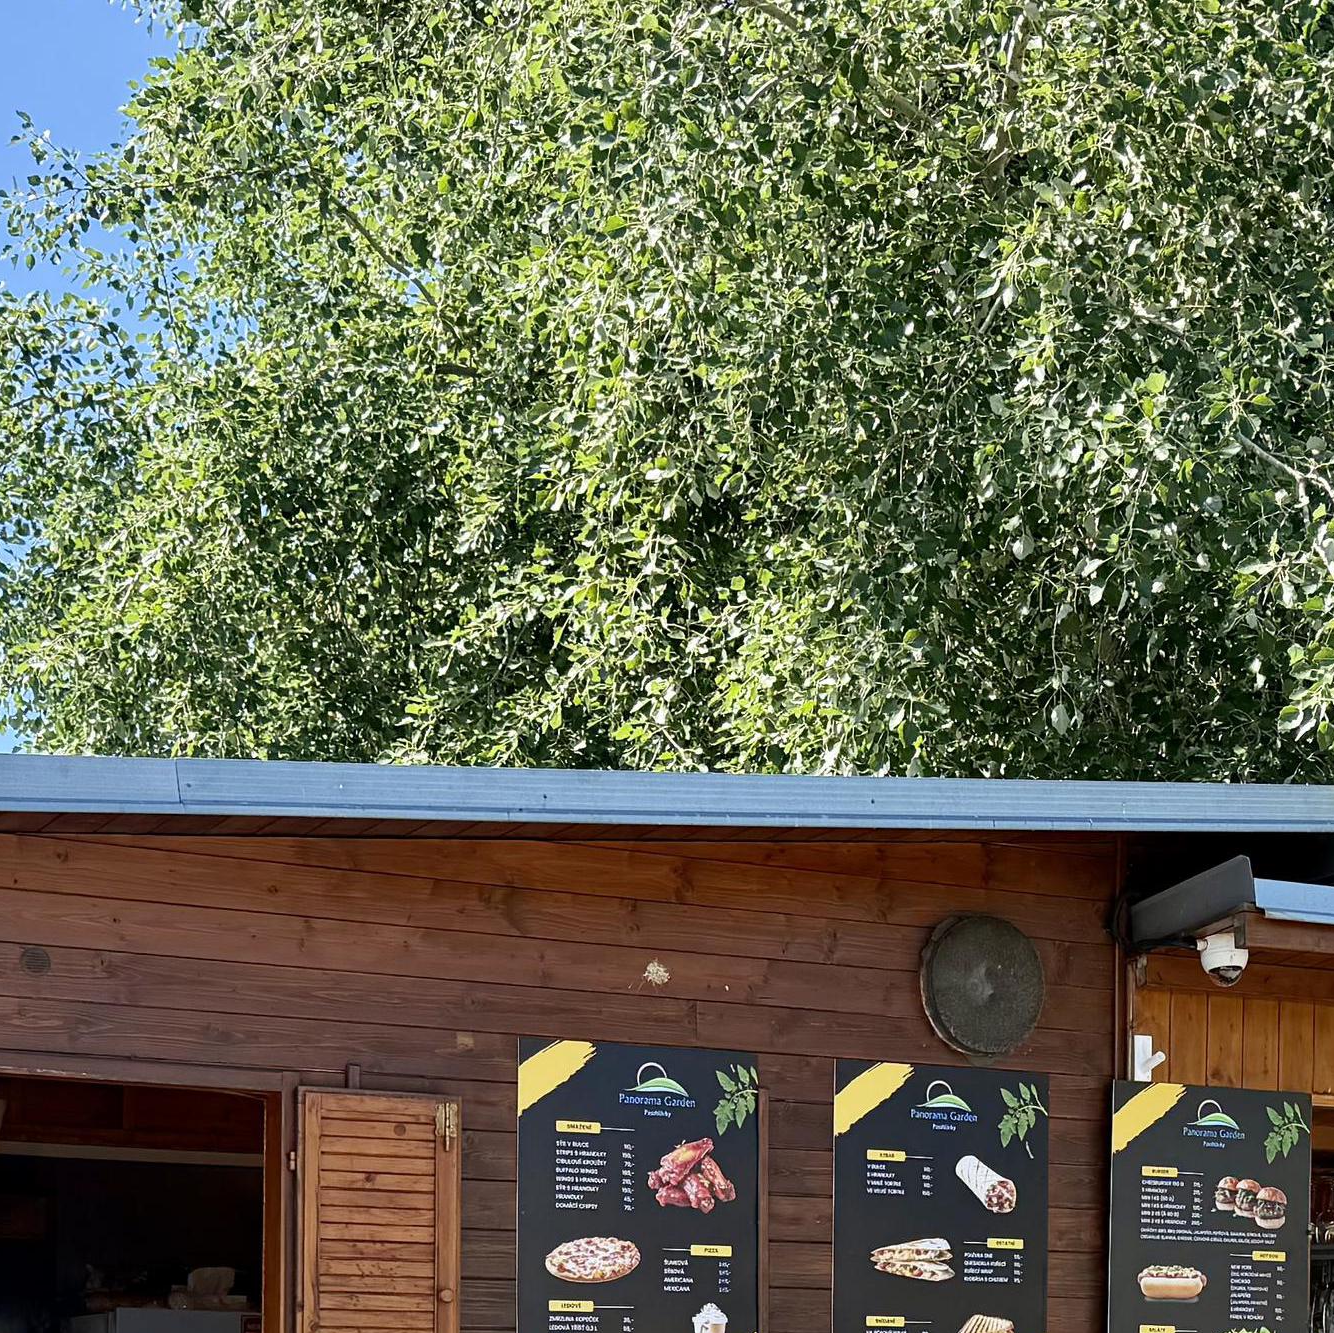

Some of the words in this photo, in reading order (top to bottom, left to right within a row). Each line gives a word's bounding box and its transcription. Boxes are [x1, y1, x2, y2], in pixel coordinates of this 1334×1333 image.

[619, 1093, 662, 1105] Panorama
[664, 1096, 696, 1108] Garden
[910, 1109, 948, 1120] Panorama
[950, 1111, 978, 1122] Garden
[1183, 1126, 1217, 1138] Panorama
[1219, 1129, 1246, 1140] Garden
